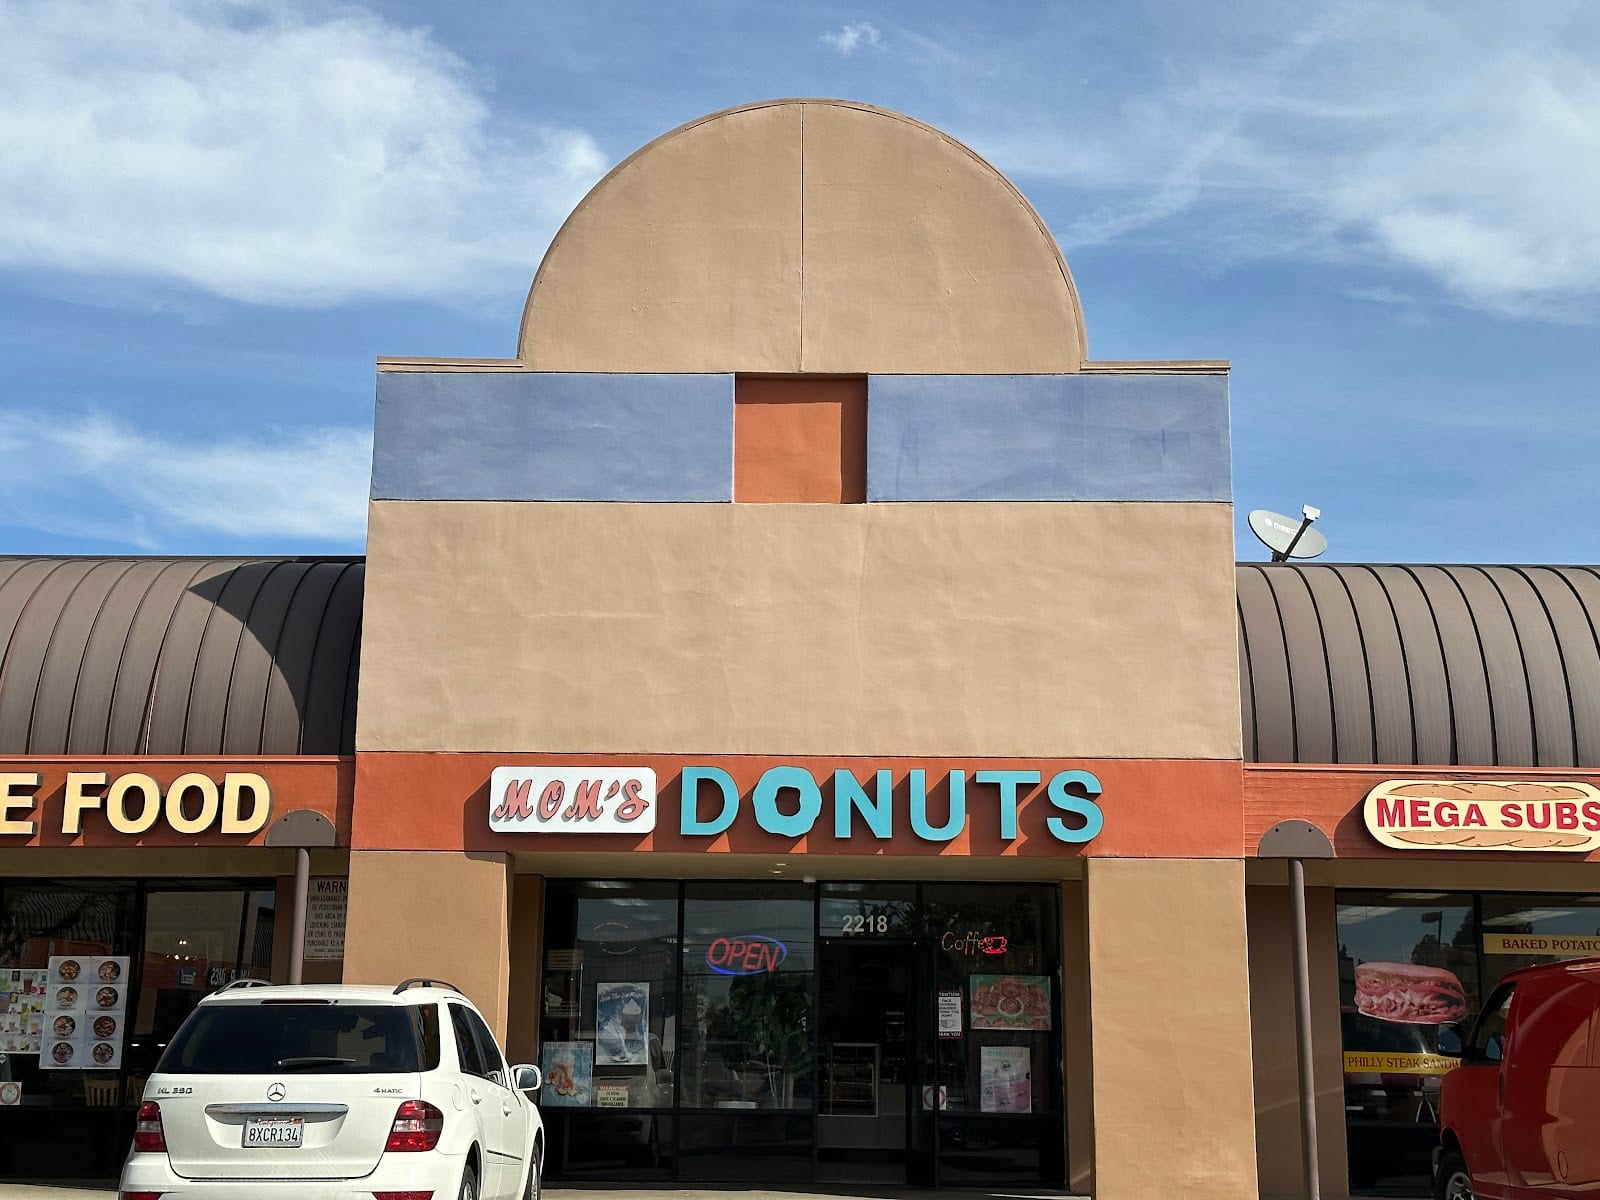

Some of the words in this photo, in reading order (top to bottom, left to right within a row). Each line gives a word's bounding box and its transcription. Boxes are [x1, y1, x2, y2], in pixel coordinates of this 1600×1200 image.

[0, 772, 39, 834] E
[61, 772, 271, 834] FOOD
[492, 778, 649, 822] MOM'S
[680, 765, 1104, 843] DONUTS
[1376, 798, 1487, 828] MEGA
[1501, 801, 1600, 832] SUBS
[842, 915, 888, 933] 2218
[707, 937, 781, 973] OPEN
[942, 931, 994, 956] Coffee
[1502, 938, 1548, 949] BAKED
[1347, 1056, 1383, 1068] PHILLY
[1386, 1057, 1421, 1069] STEAK
[248, 1127, 298, 1142] 8XCR134
